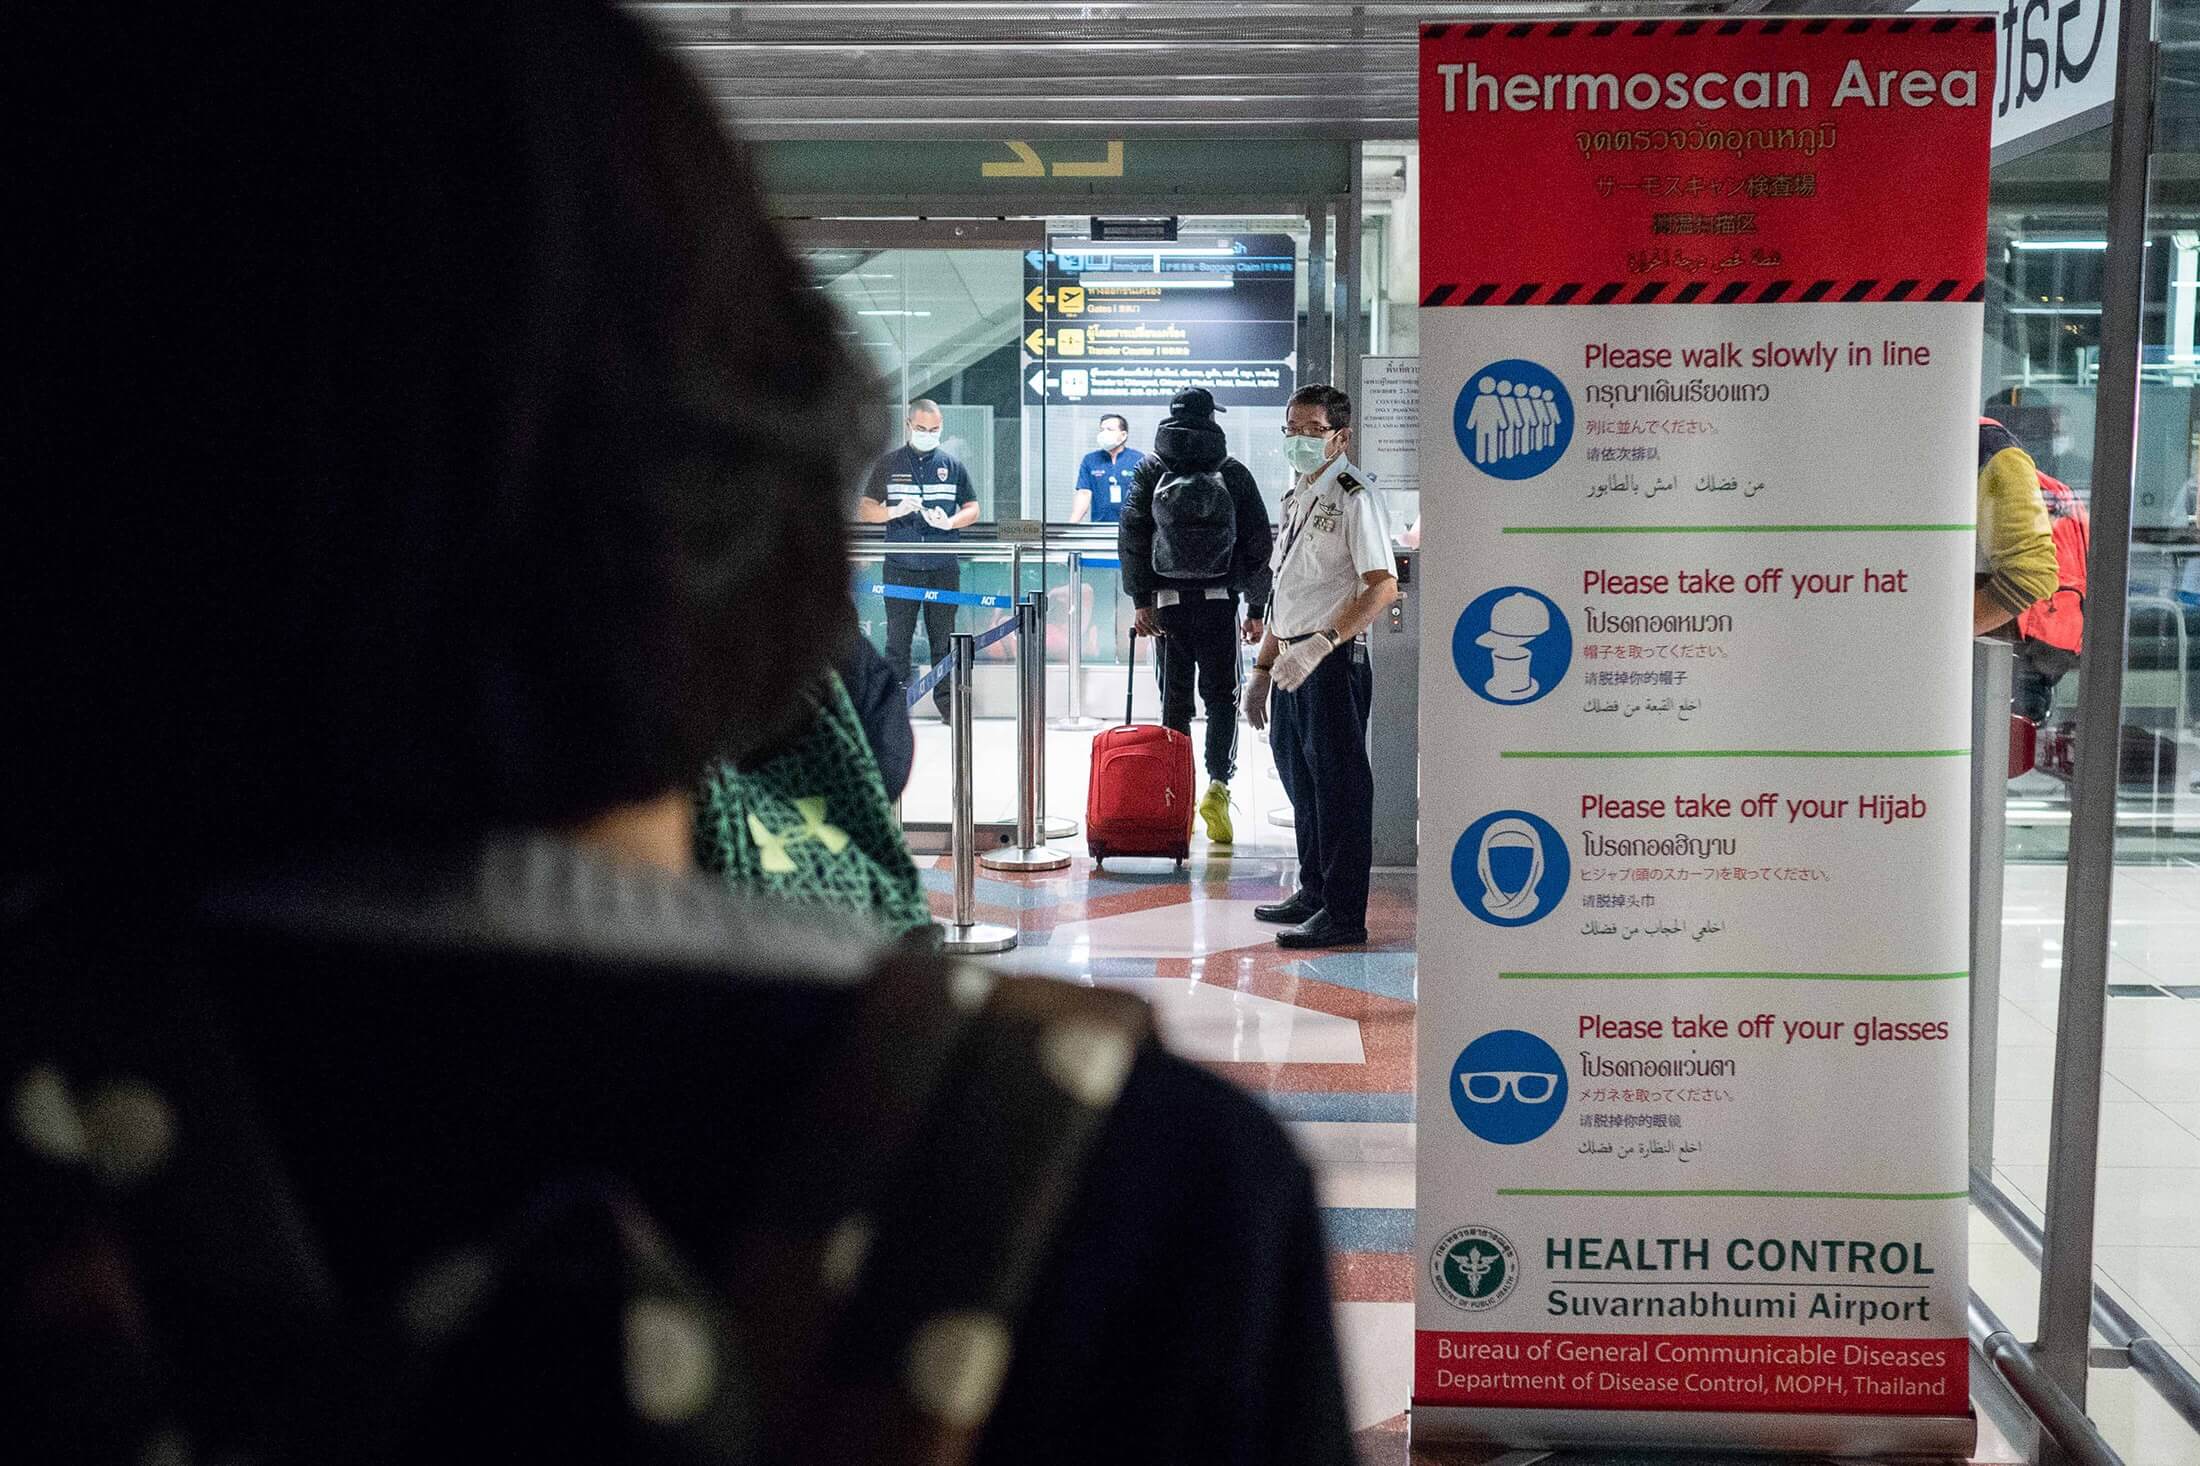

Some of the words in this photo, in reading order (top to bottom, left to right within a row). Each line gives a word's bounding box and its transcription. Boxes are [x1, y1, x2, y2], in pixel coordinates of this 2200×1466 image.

[1437, 63, 1810, 114] Thermoscan
[1832, 60, 1979, 110] Area
[1585, 344, 1672, 368] Please
[1682, 343, 1742, 368] walk
[1752, 342, 1838, 372] slowly
[1848, 342, 1871, 366] in
[1883, 342, 1931, 366] line
[925, 591, 939, 600] AOT
[1583, 570, 1669, 594] Please
[1678, 569, 1735, 593] take
[1745, 568, 1783, 593] off
[1791, 573, 1854, 599] your
[1864, 568, 1908, 593] hat
[981, 596, 996, 606] AOT
[1581, 795, 1665, 818] Please
[1675, 794, 1731, 818] take
[1741, 793, 1779, 817] off
[1787, 798, 1848, 823] your
[1859, 794, 1927, 825] Hijab
[1579, 1015, 1663, 1040] Please
[1672, 1014, 1728, 1039] take
[1738, 1014, 1776, 1038] off
[1783, 1020, 1845, 1044] your
[1853, 1016, 1949, 1046] glasses
[1547, 1238, 1708, 1271] HEALTH
[1726, 1238, 1935, 1275] CONTROL
[1547, 1289, 1796, 1319] Suvarnabhumi
[1810, 1291, 1930, 1326] Airport
[1438, 1340, 1520, 1361] Bureau
[1526, 1340, 1551, 1361] of
[1557, 1341, 1648, 1363] General
[1656, 1341, 1836, 1365] Communicable
[1844, 1345, 1946, 1367] Diseases
[1437, 1369, 1565, 1394] Department
[1572, 1371, 1594, 1390] of
[1599, 1372, 1678, 1392] Disease
[1685, 1373, 1768, 1394] Control,
[1775, 1374, 1848, 1396] MOPH,
[1853, 1375, 1946, 1396] Thailand
